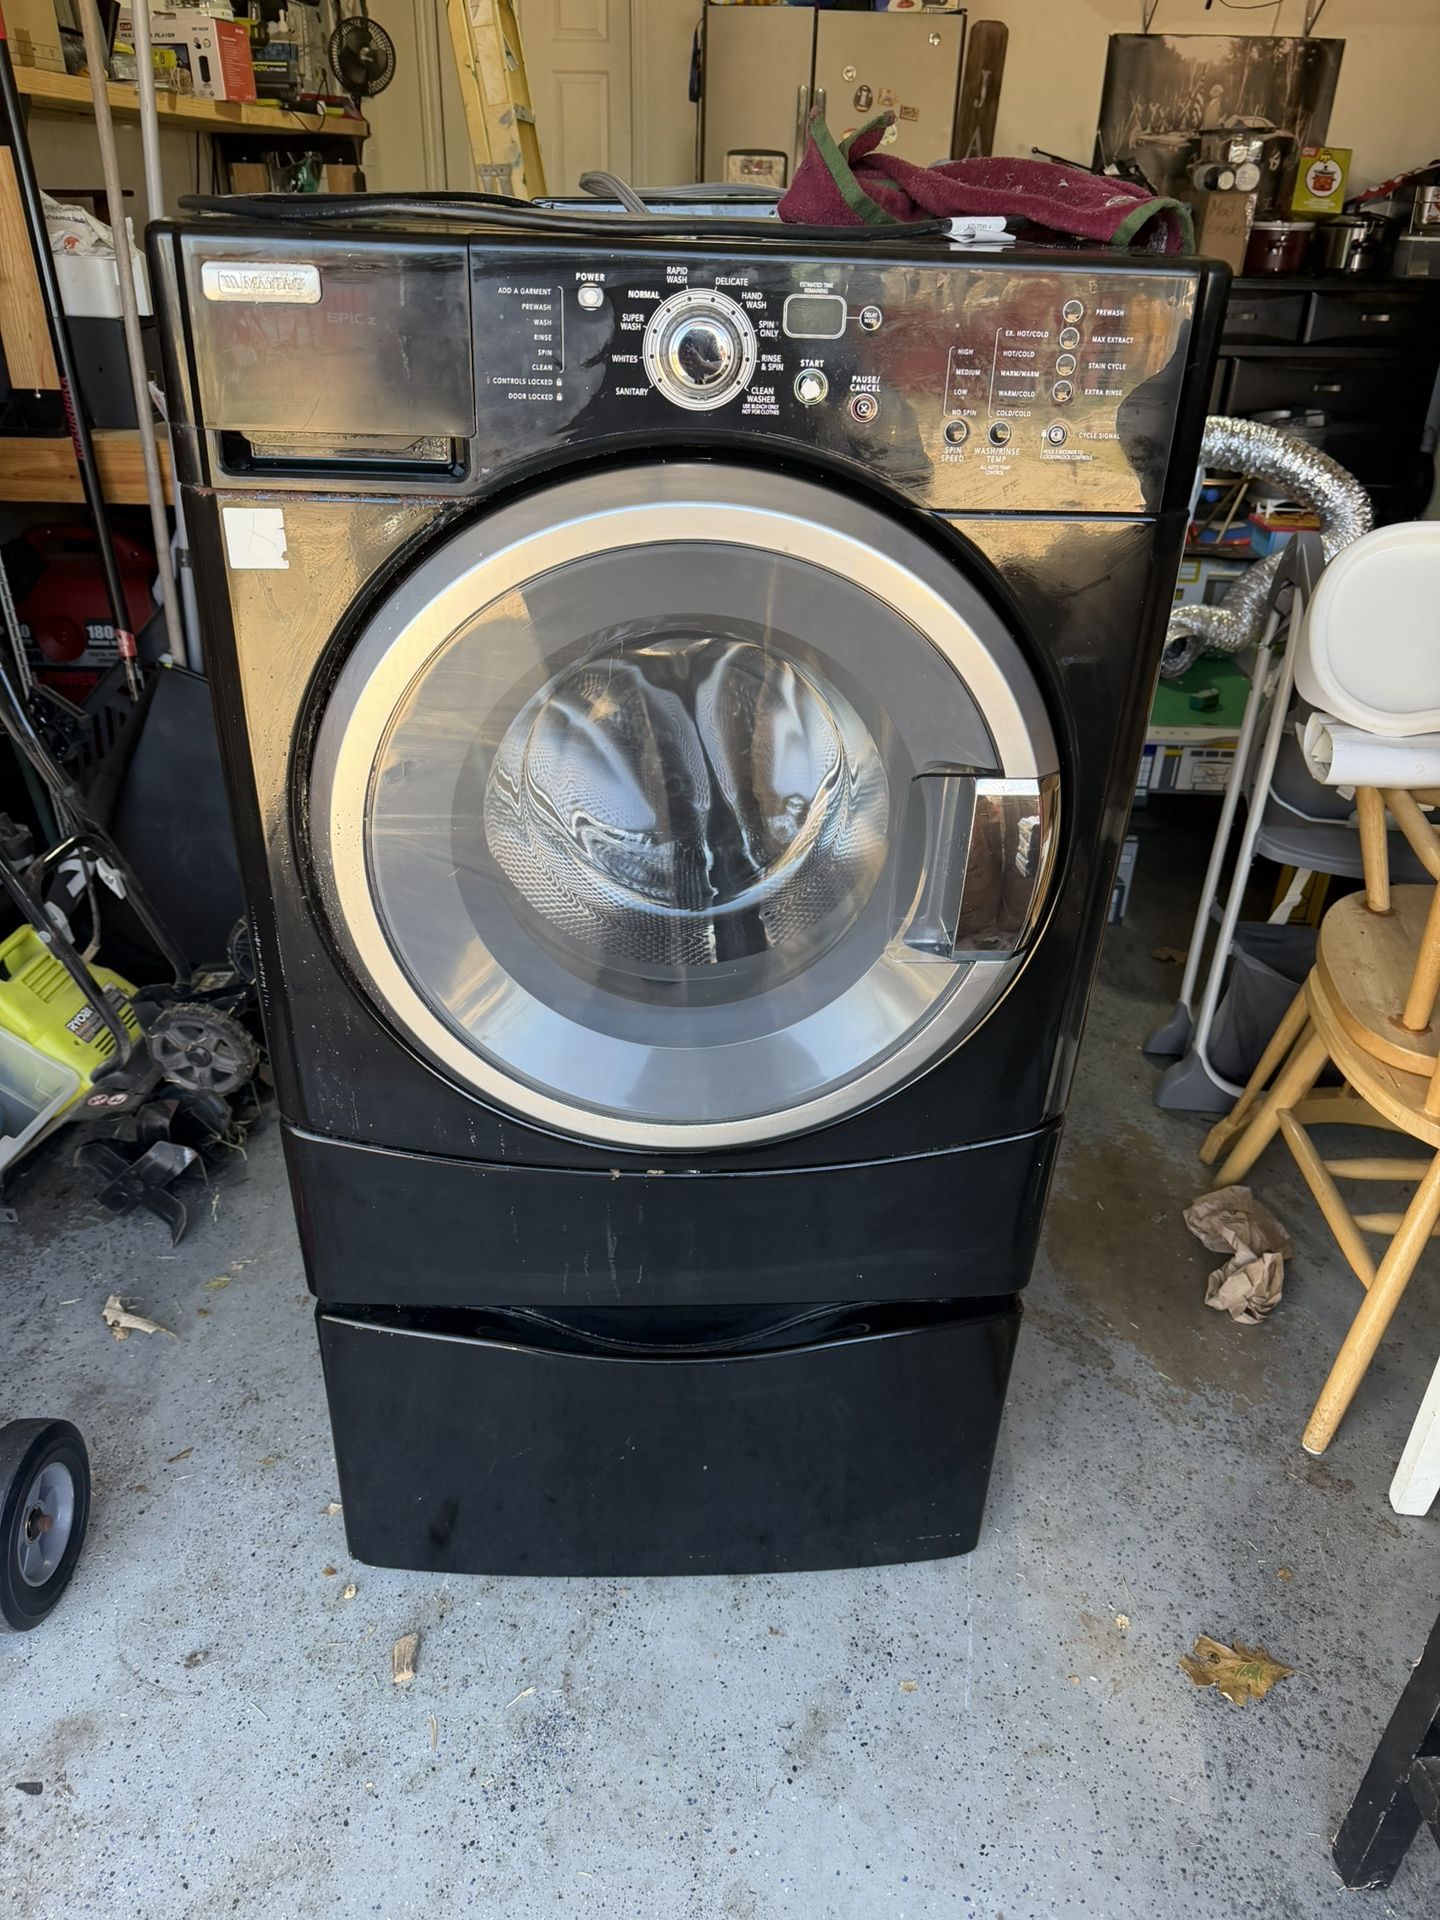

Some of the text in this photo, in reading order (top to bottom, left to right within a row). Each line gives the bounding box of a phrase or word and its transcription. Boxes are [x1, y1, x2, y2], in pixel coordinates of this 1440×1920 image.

[666, 266, 688, 275] RAPID
[575, 272, 606, 282] POWER
[666, 275, 688, 284] WASH
[715, 277, 749, 286] DELICATE
[242, 275, 306, 291] MAYTAG
[628, 290, 660, 299] NORMAL
[741, 292, 763, 300] HAND
[521, 303, 552, 311] PREWASH
[745, 301, 767, 309] WASH
[622, 313, 645, 322] SUPER
[1095, 309, 1125, 317] PREWASH
[326, 312, 362, 324] EPIC
[620, 322, 642, 331] WASH
[758, 320, 775, 329] SPIN
[760, 329, 779, 338] ONLY
[1017, 330, 1049, 338] HOT/COLD
[611, 354, 638, 363] WHITES
[761, 354, 782, 363] RINSE
[1003, 350, 1035, 358] HOT/COLD
[531, 363, 553, 371] CLEAN
[760, 362, 784, 371] & SPIN
[800, 359, 825, 368] START
[1107, 363, 1127, 371] CYCLE
[955, 368, 981, 376] MEDIUM
[1000, 370, 1040, 378] WARM/WARM
[492, 377, 553, 386] CONTROLS LOCKED
[851, 375, 881, 384] PAUSE/
[615, 387, 649, 396] SANITARY
[751, 386, 775, 395] CLEAN
[850, 384, 881, 393] CANCEL
[1084, 388, 1103, 396] EXTRA
[508, 392, 554, 401] DOOR LOCKED
[746, 394, 776, 403] WASHER
[998, 390, 1035, 398] WARM/COLD
[944, 446, 962, 454] SPIN
[974, 447, 1020, 456] WASH/RINSE
[86, 624, 115, 640] 180
[66, 1006, 94, 1032] RYOBI
